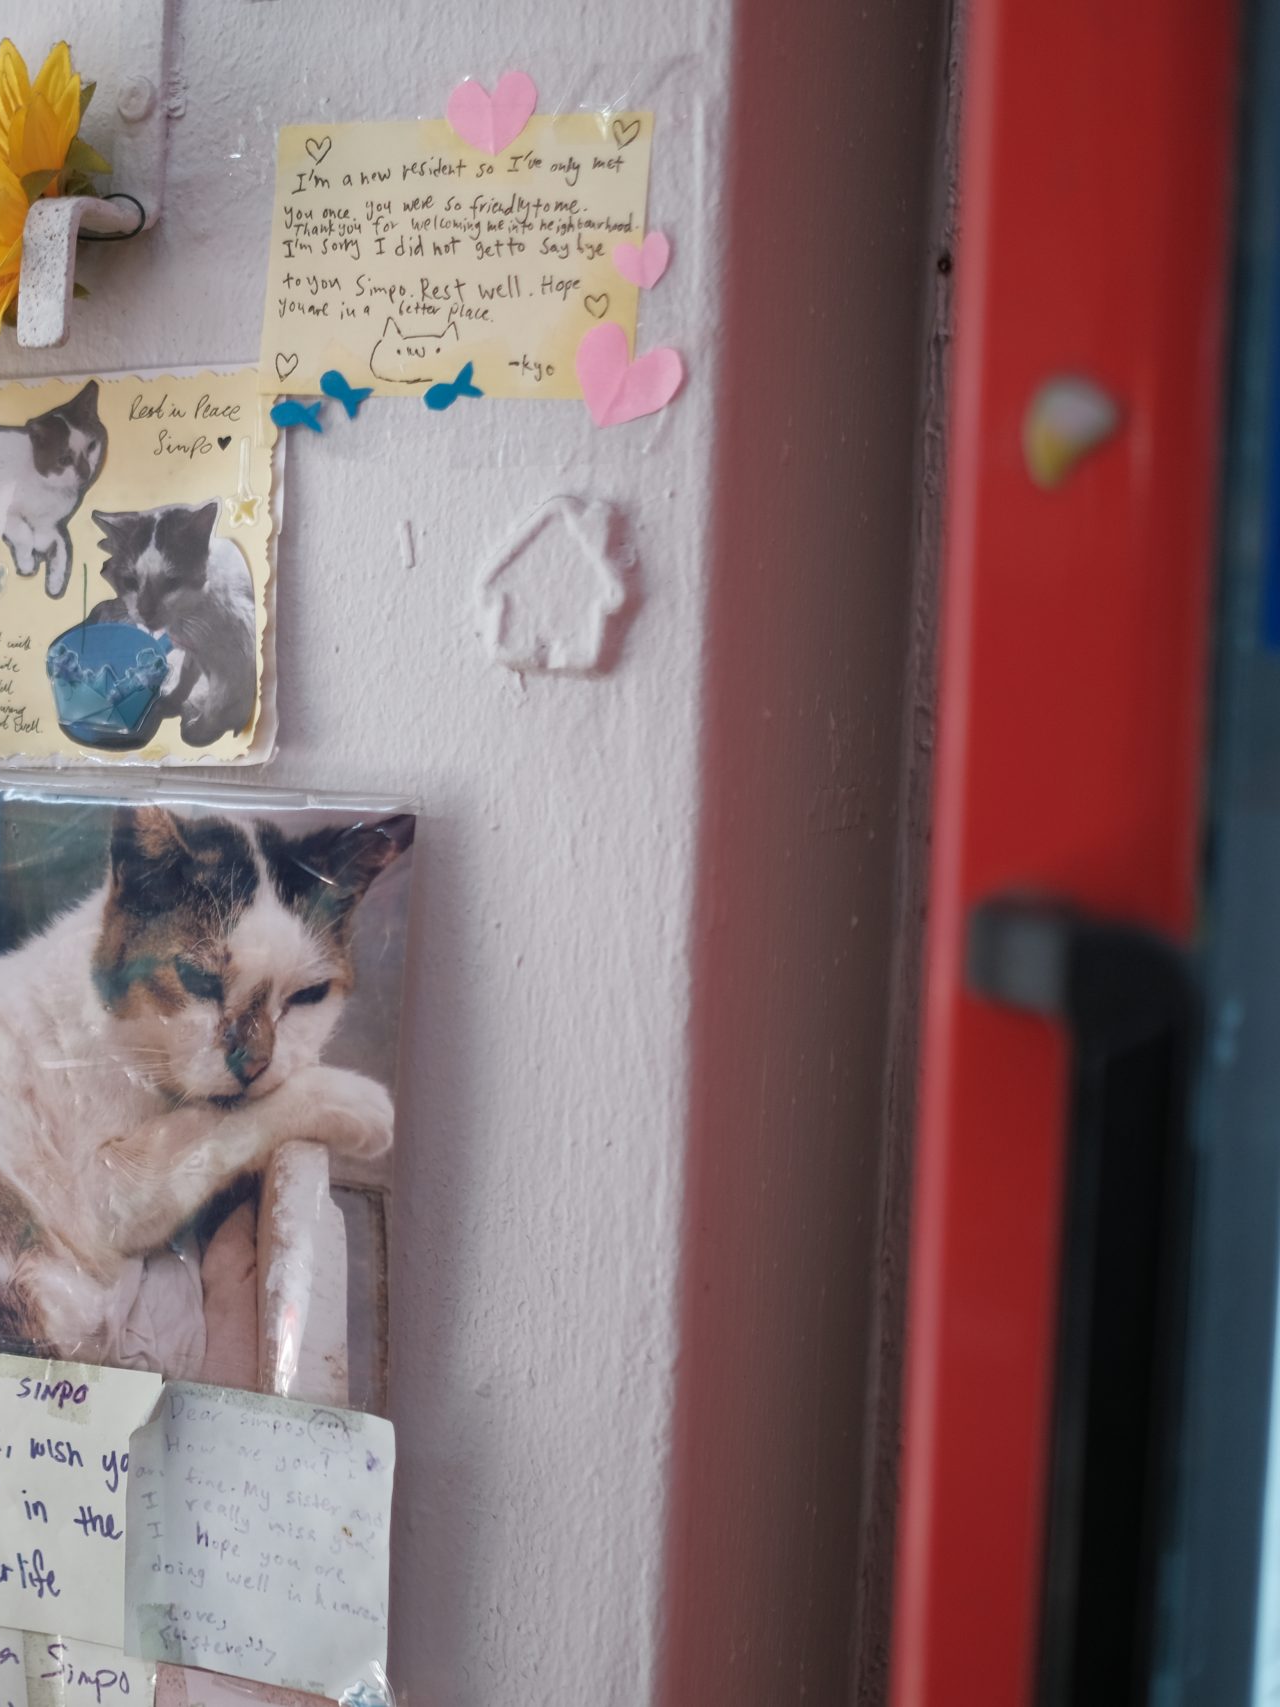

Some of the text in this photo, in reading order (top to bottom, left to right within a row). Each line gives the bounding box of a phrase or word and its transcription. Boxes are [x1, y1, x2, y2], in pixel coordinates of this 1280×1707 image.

[291, 150, 624, 195] I'm a new resident so I've only met
[283, 206, 313, 229] you
[322, 207, 357, 222] once.
[403, 195, 434, 213] were
[444, 196, 462, 211] so
[372, 216, 399, 235] for
[411, 215, 481, 240] welcoming
[282, 239, 312, 258] I'm
[374, 237, 386, 255] I
[395, 236, 424, 257] did
[433, 237, 461, 256] not
[577, 233, 605, 260] bye
[283, 273, 301, 289] to
[306, 275, 342, 295] you
[421, 278, 466, 302] Rest
[541, 275, 581, 301] Hope
[340, 302, 356, 320] in
[363, 304, 371, 315] a
[398, 300, 441, 316] better
[447, 301, 494, 323] place.
[128, 394, 241, 421] Rest in Peace
[169, 1395, 223, 1422] Dear
[165, 1434, 216, 1453] How
[102, 1450, 130, 1493] yo
[21, 1489, 48, 1523] in
[73, 1505, 124, 1540] the
[243, 1480, 272, 1512] My
[286, 1491, 342, 1517] sister
[141, 1491, 159, 1510] I
[184, 1497, 251, 1534] really
[268, 1519, 317, 1542] miss
[147, 1522, 164, 1540] I
[195, 1521, 242, 1560] hope
[259, 1551, 302, 1571] you
[151, 1554, 207, 1589] doing
[225, 1569, 269, 1593] well
[287, 1583, 303, 1604] in
[40, 1642, 131, 1704] Simpo
